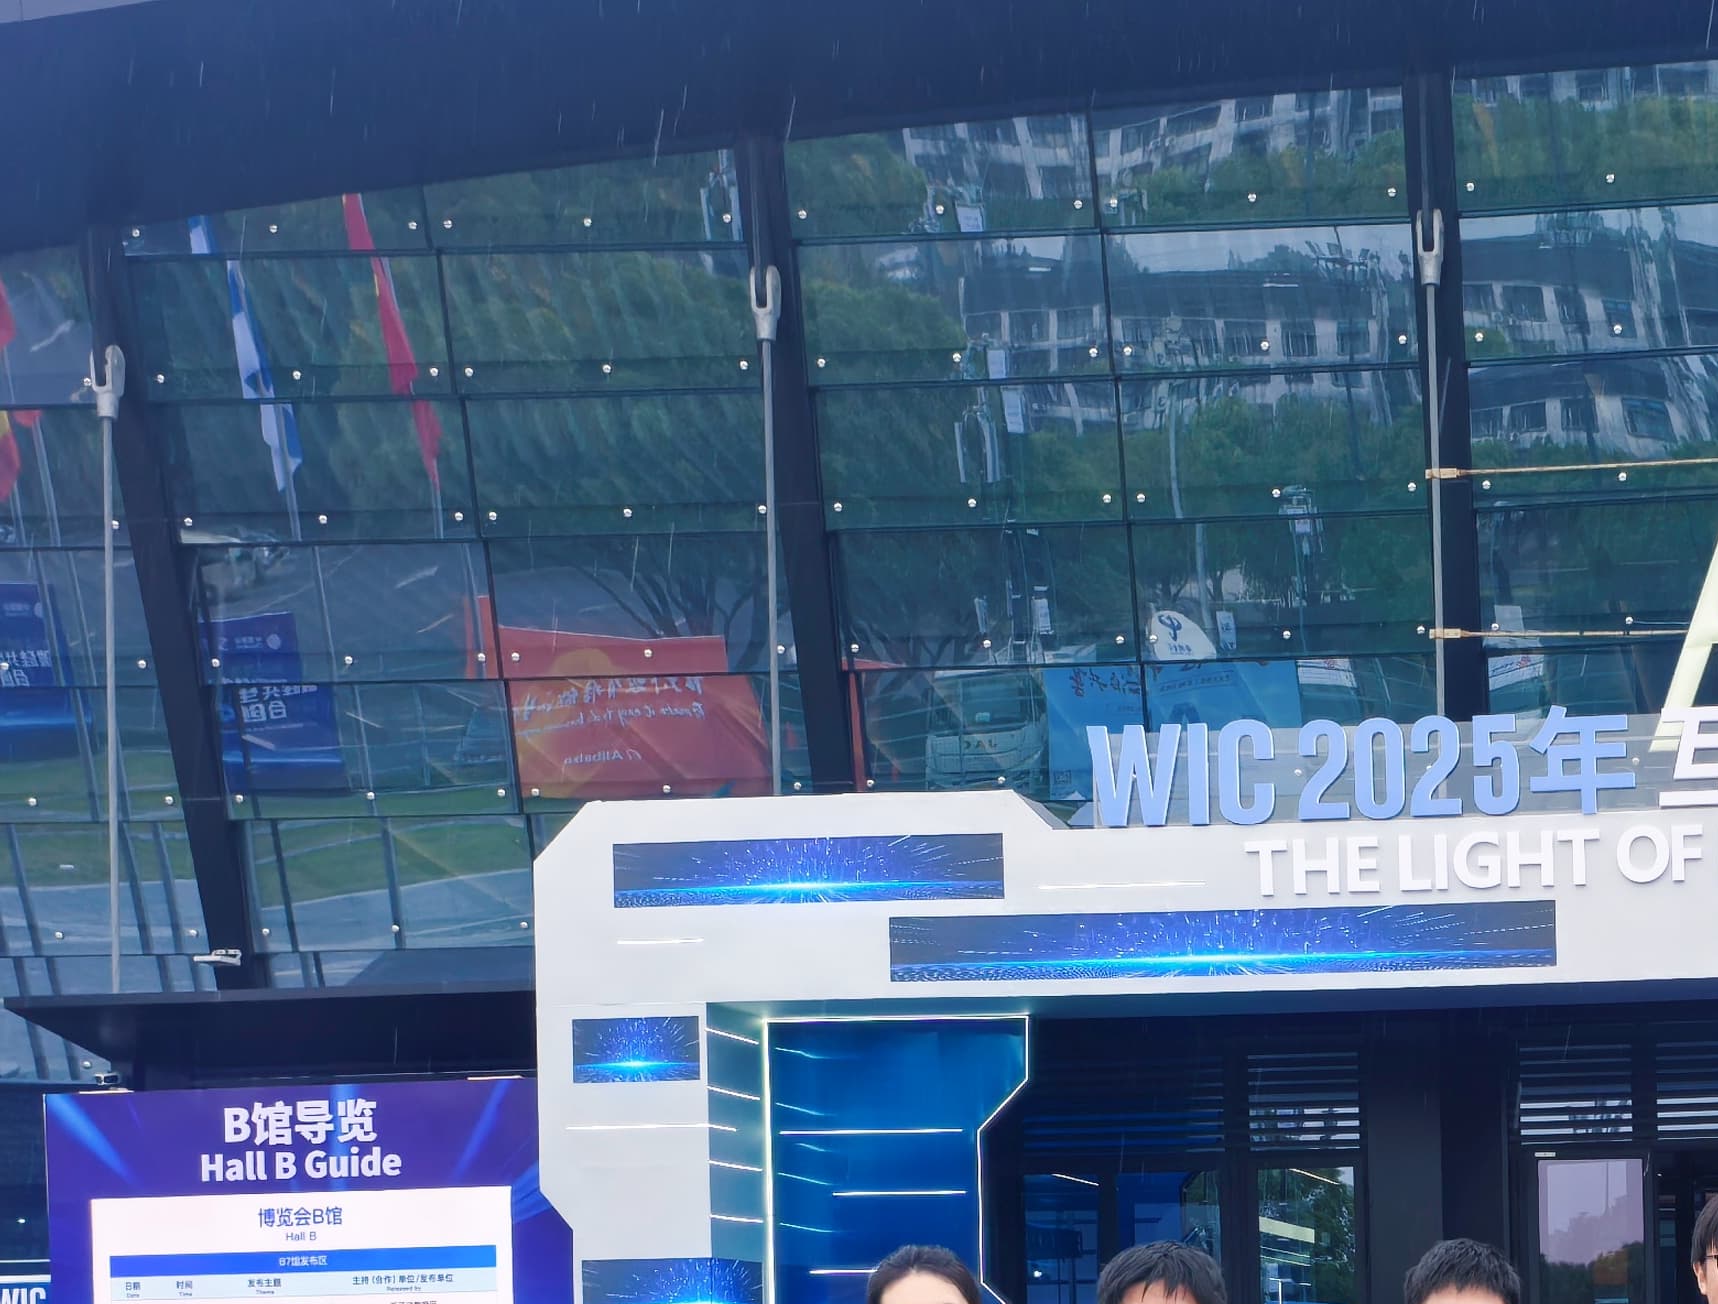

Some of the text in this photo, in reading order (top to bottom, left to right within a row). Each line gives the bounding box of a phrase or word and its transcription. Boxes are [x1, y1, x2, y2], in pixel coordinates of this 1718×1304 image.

[1086, 719, 1275, 829] WIC
[1299, 704, 1637, 823] 2025年
[1245, 836, 1380, 897] THE
[1400, 829, 1599, 891] LIGHT
[1616, 823, 1703, 886] OF
[224, 1098, 377, 1146] B馆导览
[201, 1146, 402, 1182] Hall B Guide
[258, 1206, 343, 1228] 博览会B馆
[285, 1231, 317, 1241] Hall B
[176, 1280, 193, 1290] 时间
